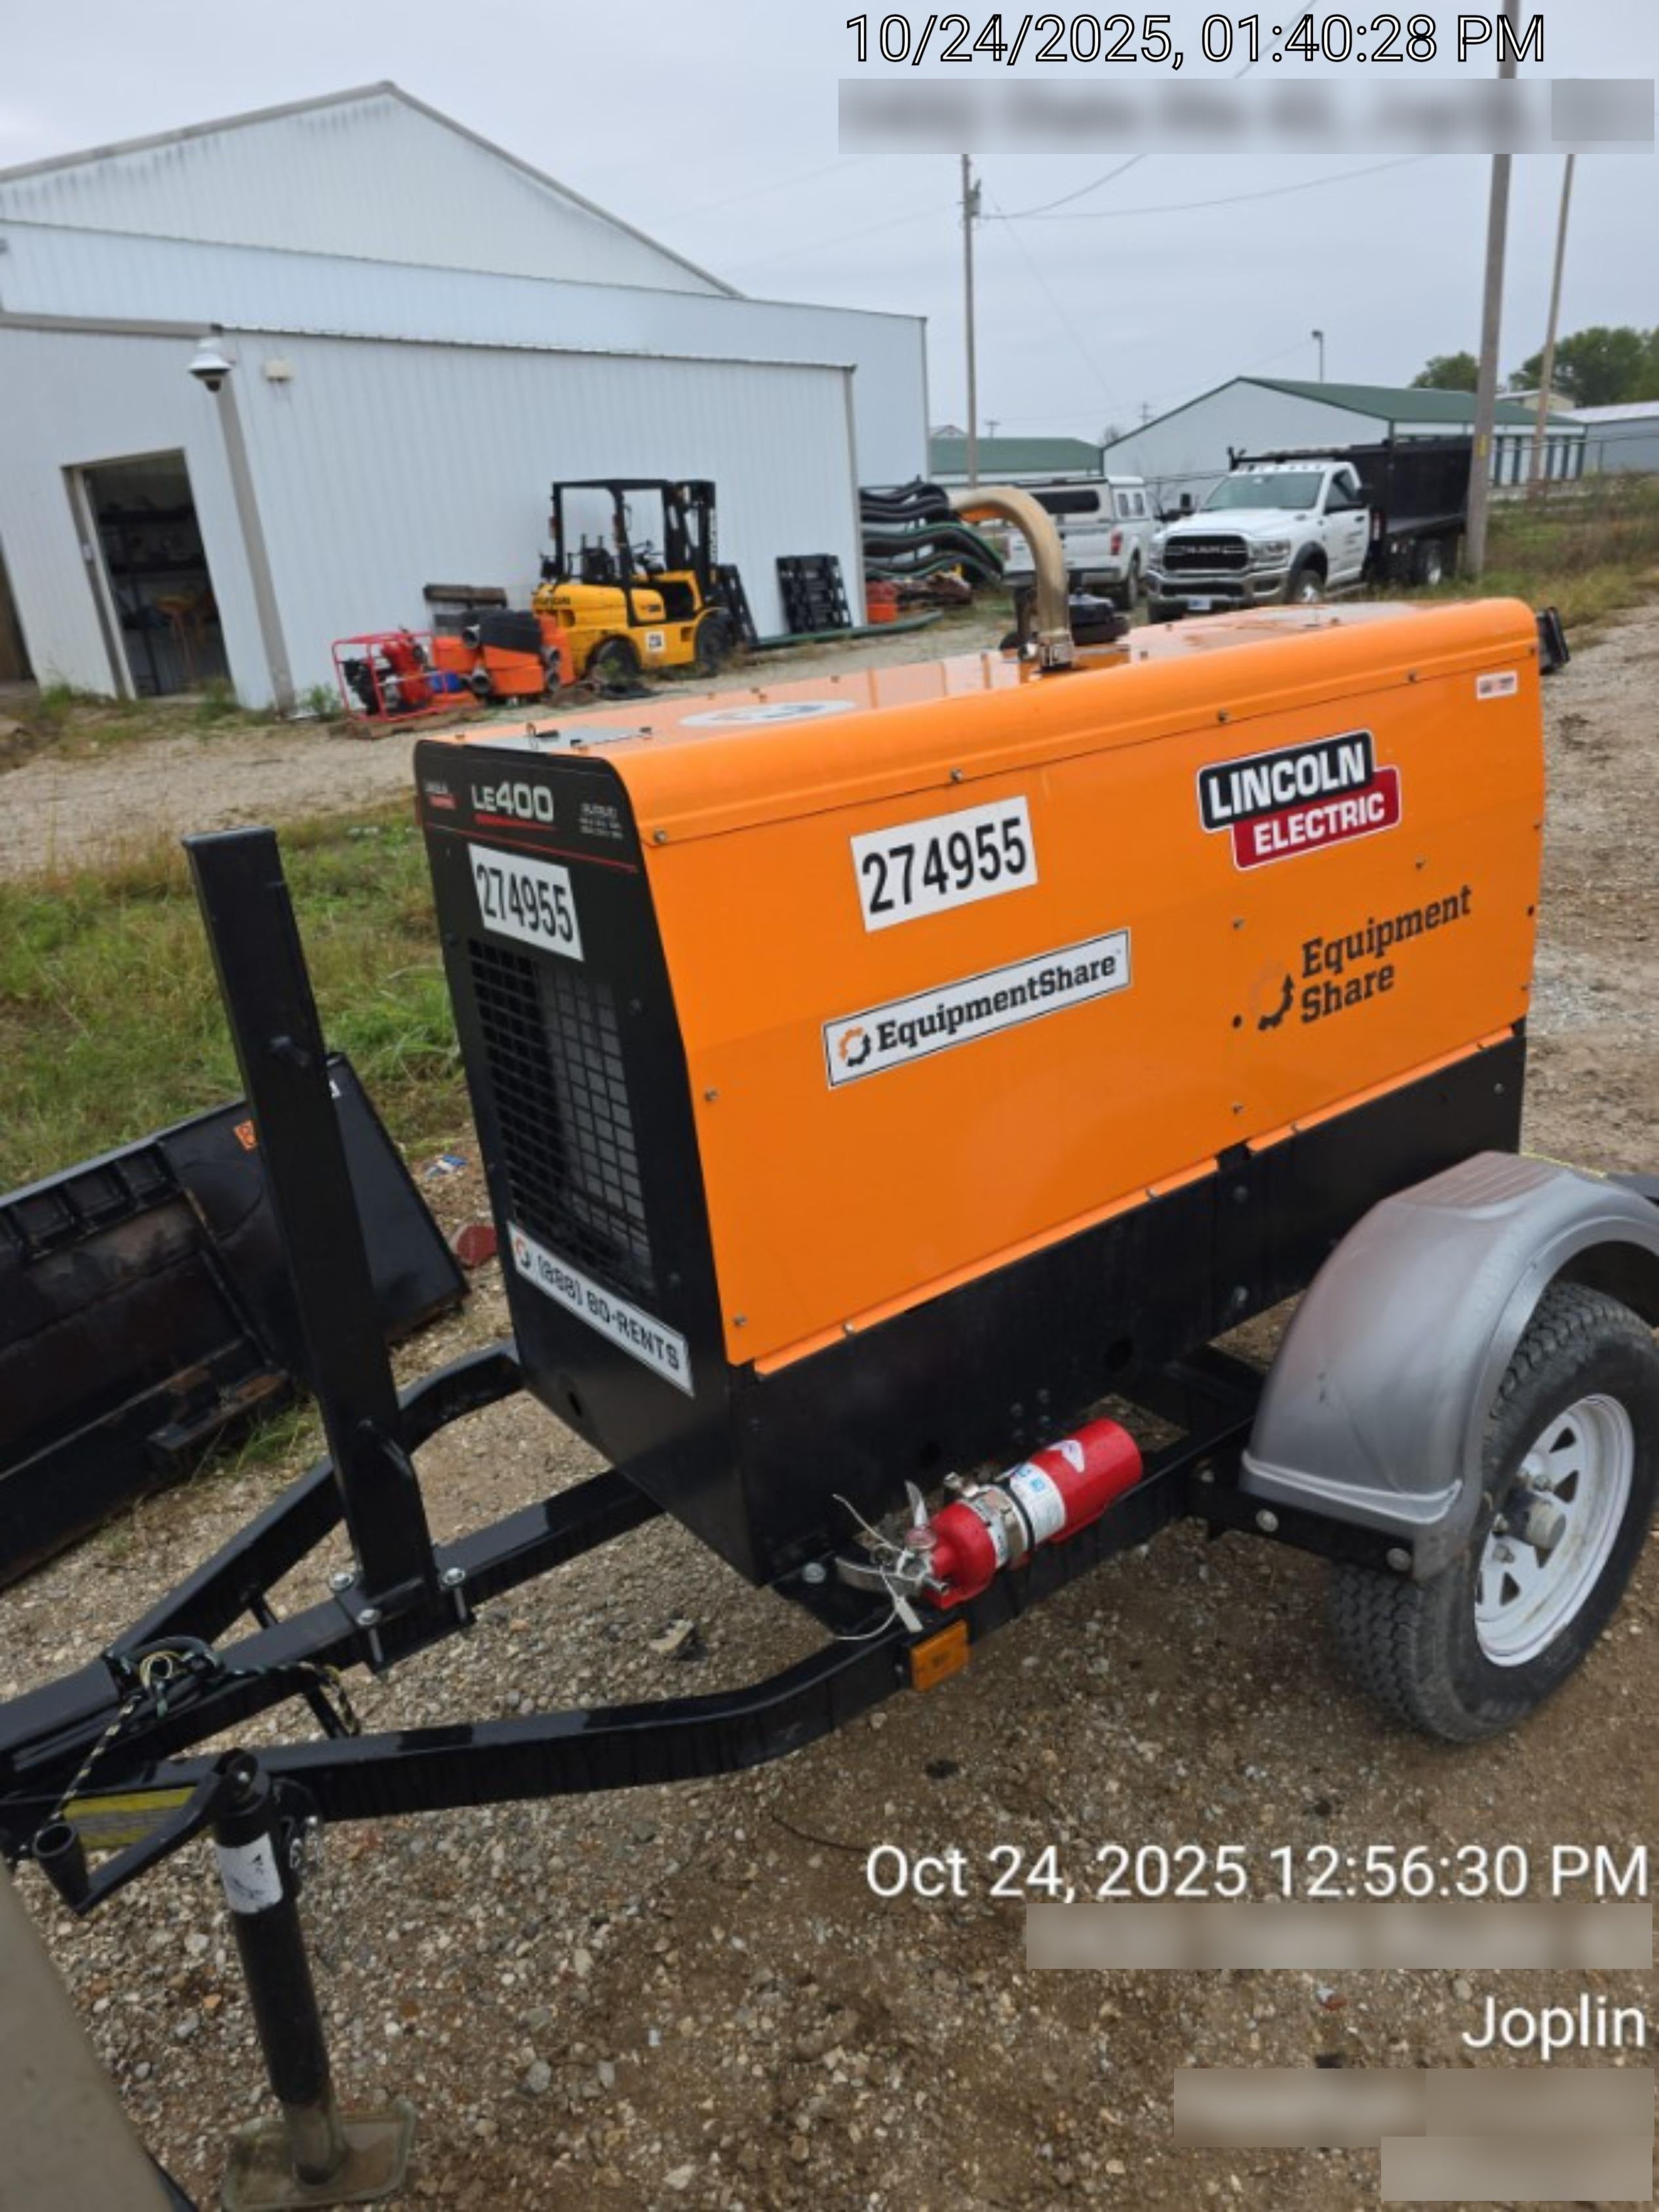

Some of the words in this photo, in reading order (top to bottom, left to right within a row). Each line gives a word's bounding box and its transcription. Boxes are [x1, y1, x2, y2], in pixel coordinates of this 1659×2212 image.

[471, 781, 555, 823] LE400
[1208, 742, 1367, 820] LINCOLN
[1252, 792, 1386, 857] ELECTRIC
[476, 863, 574, 943] 274955
[862, 816, 1027, 914] 274955
[1302, 884, 1472, 979] Equipment
[876, 953, 1116, 1055] EquipmentShare
[1300, 963, 1395, 1024] Share
